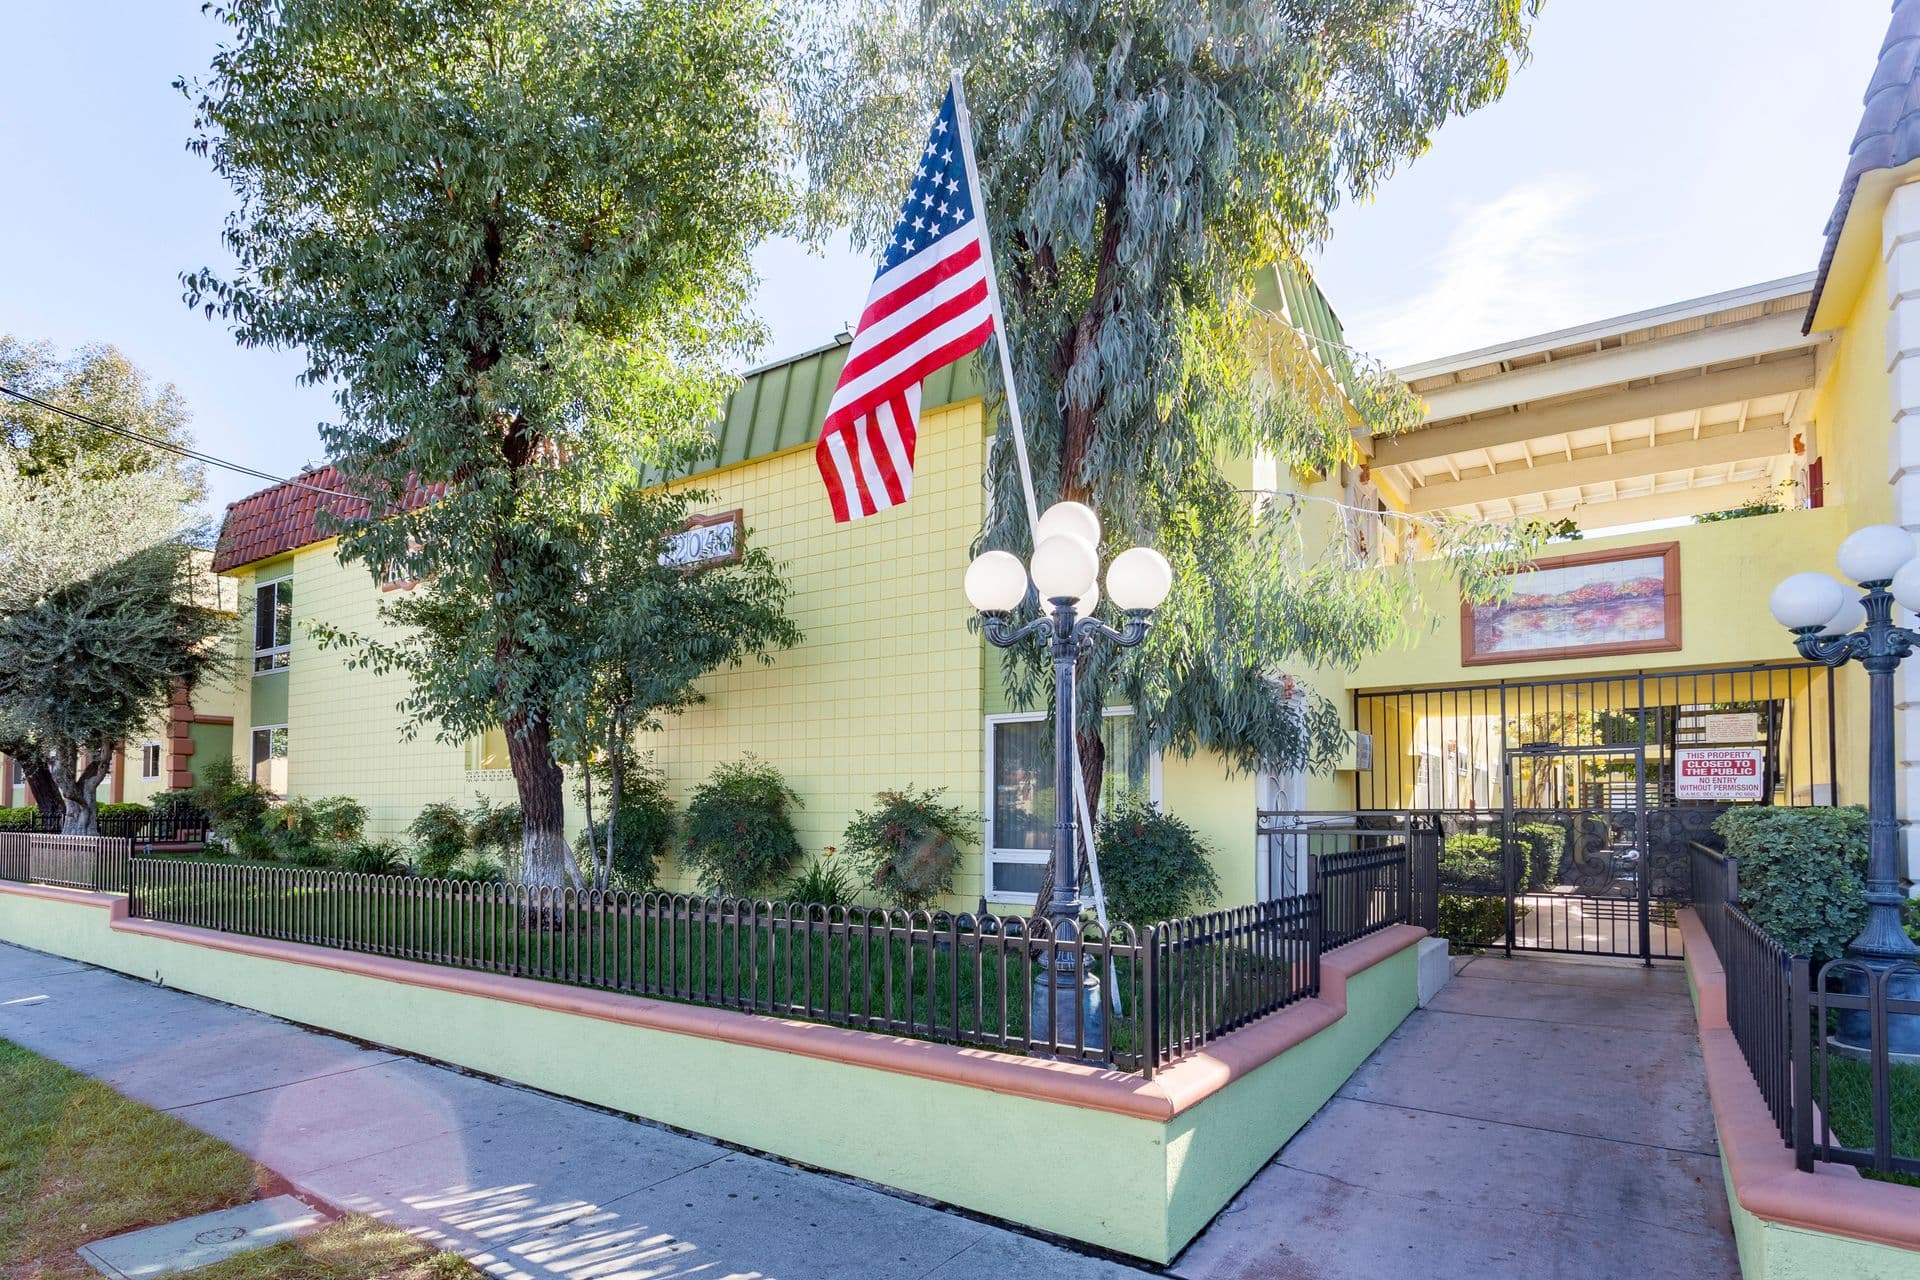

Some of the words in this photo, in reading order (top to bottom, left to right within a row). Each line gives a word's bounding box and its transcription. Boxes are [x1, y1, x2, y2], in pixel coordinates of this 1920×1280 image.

[1707, 751, 1751, 759] PROPERTY
[1687, 760, 1732, 768] CLOSED
[1734, 760, 1750, 768] TO
[1685, 768, 1708, 776] THE
[1710, 767, 1753, 775] PUBLIC
